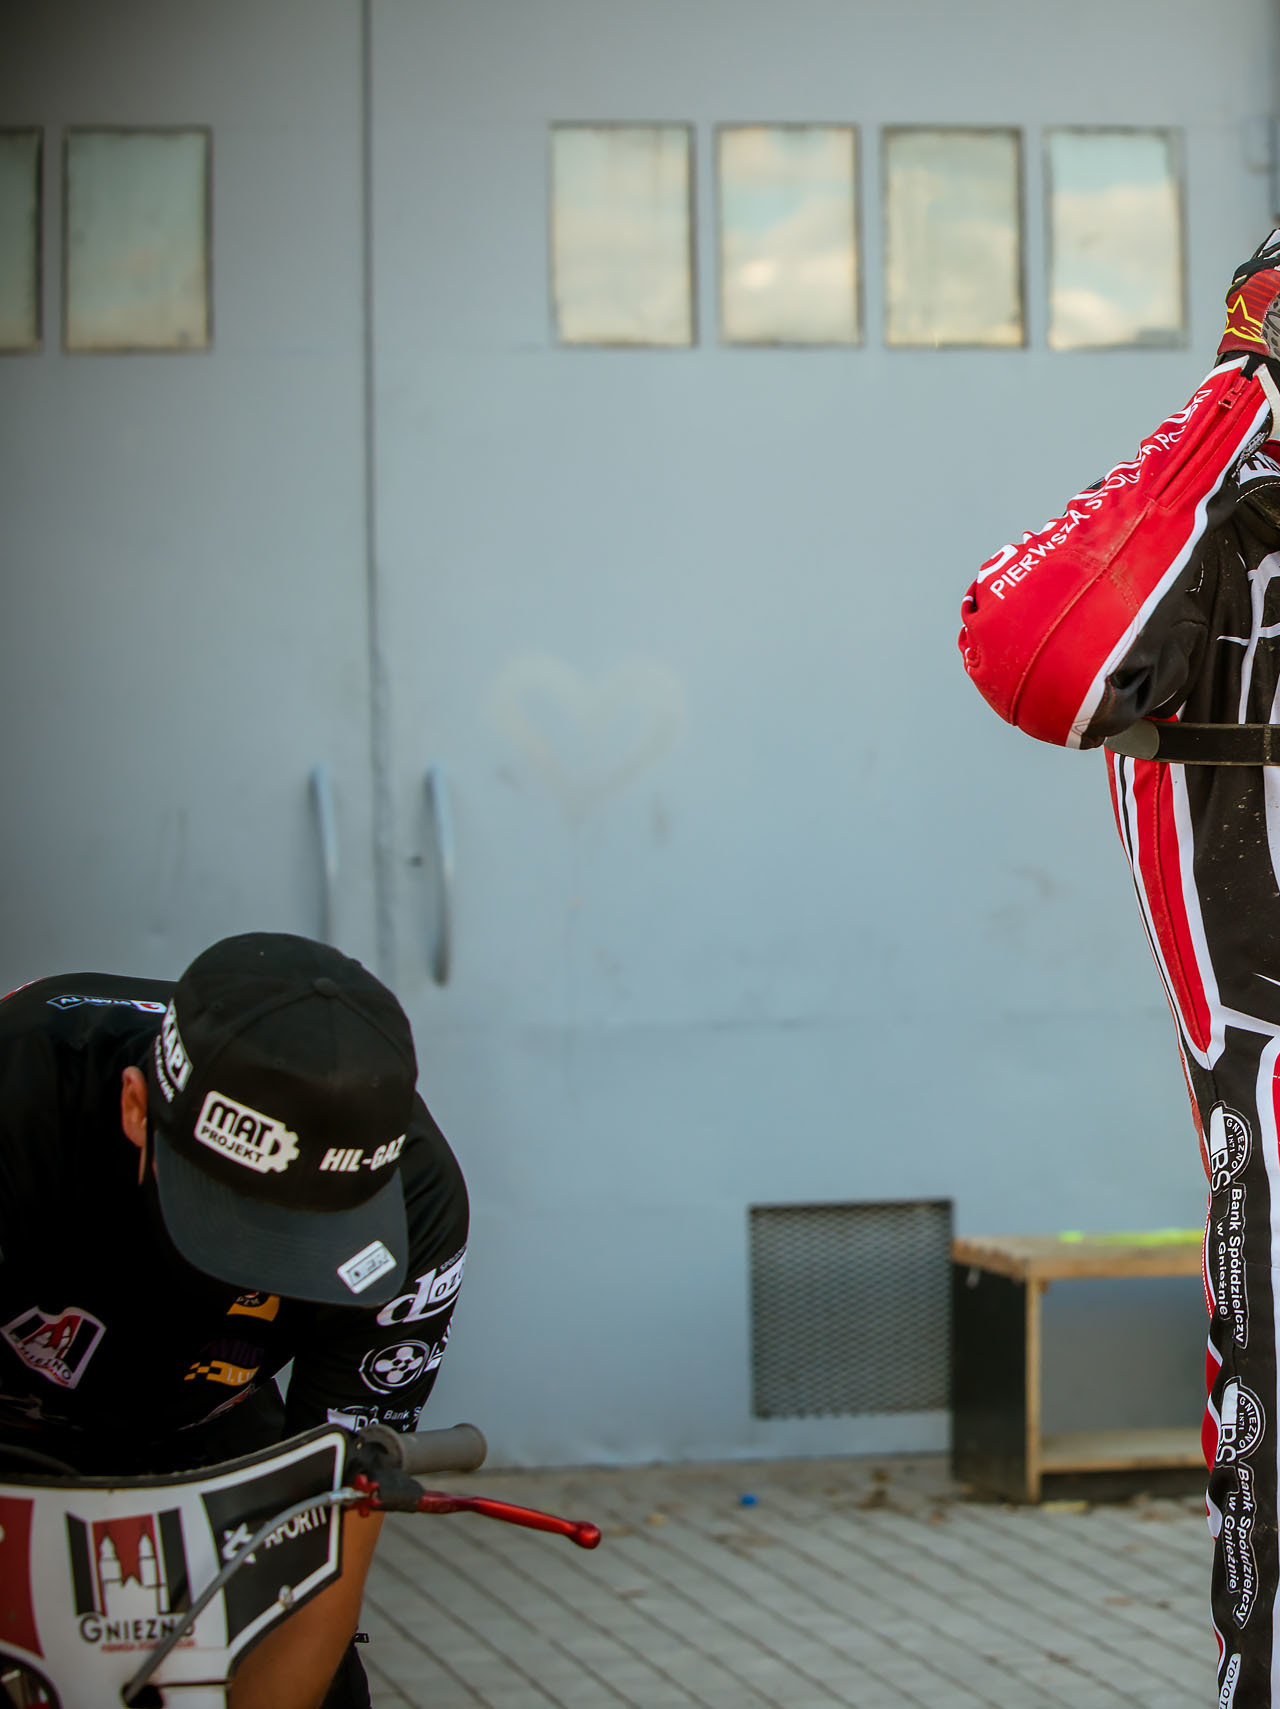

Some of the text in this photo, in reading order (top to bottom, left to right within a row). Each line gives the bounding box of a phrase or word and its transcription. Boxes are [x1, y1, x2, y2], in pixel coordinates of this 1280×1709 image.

[989, 509, 1090, 600] PIERWSZA
[201, 1125, 264, 1164] PROJEKT
[319, 1134, 406, 1172] HIL-GAZ
[1226, 1118, 1246, 1169] GNIEZNO
[1210, 1148, 1231, 1192] BS
[1229, 1187, 1242, 1231] Bank
[1217, 1221, 1229, 1316] w Gnieźnie
[1238, 1396, 1257, 1449] GNIEZNO
[1225, 1495, 1239, 1590] w Gnieźnie
[1235, 1466, 1253, 1623] Bank Spółdzielczy
